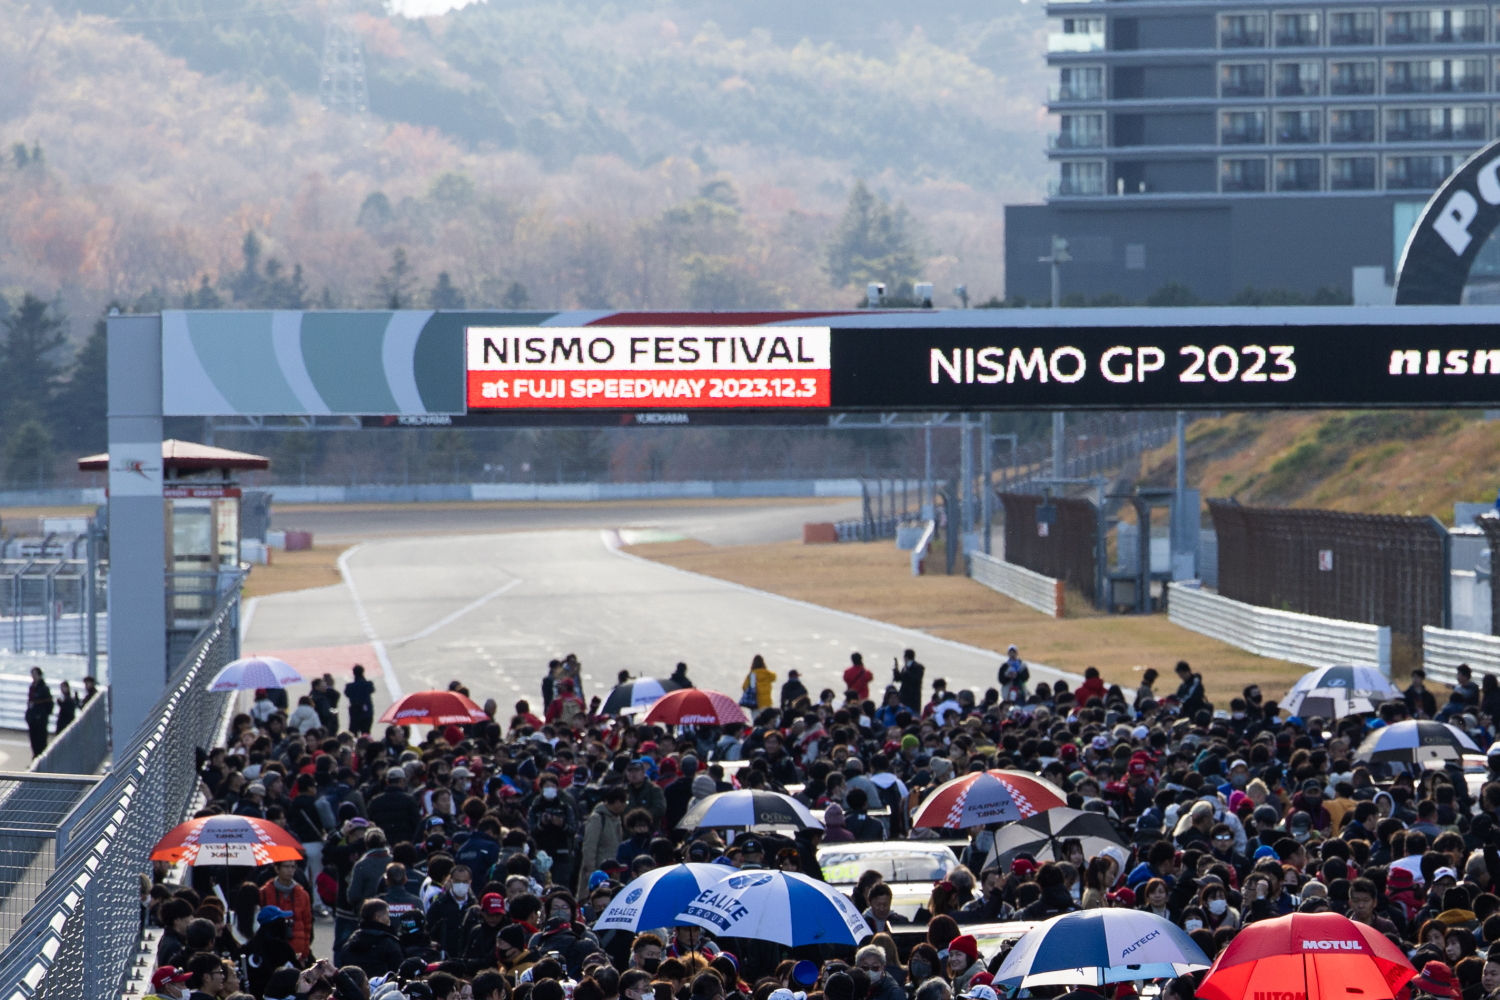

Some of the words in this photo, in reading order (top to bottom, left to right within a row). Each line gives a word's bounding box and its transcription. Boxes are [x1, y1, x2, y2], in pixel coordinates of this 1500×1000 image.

[483, 336, 615, 364] NISMO
[630, 336, 815, 364] FESTIVAL
[930, 346, 1087, 384] NISMO
[1100, 346, 1165, 383] GP
[1179, 345, 1297, 383] 2023
[481, 379, 509, 399] at
[513, 379, 566, 398] FUJI
[570, 379, 706, 398] SPEEDWAY
[709, 378, 817, 398] 2023.12.3
[608, 908, 638, 917] REALIZE
[687, 905, 726, 928] GROUP
[698, 888, 749, 922] EALIZE
[1121, 930, 1160, 958] AUTECH
[1302, 940, 1362, 950] MOTUL
